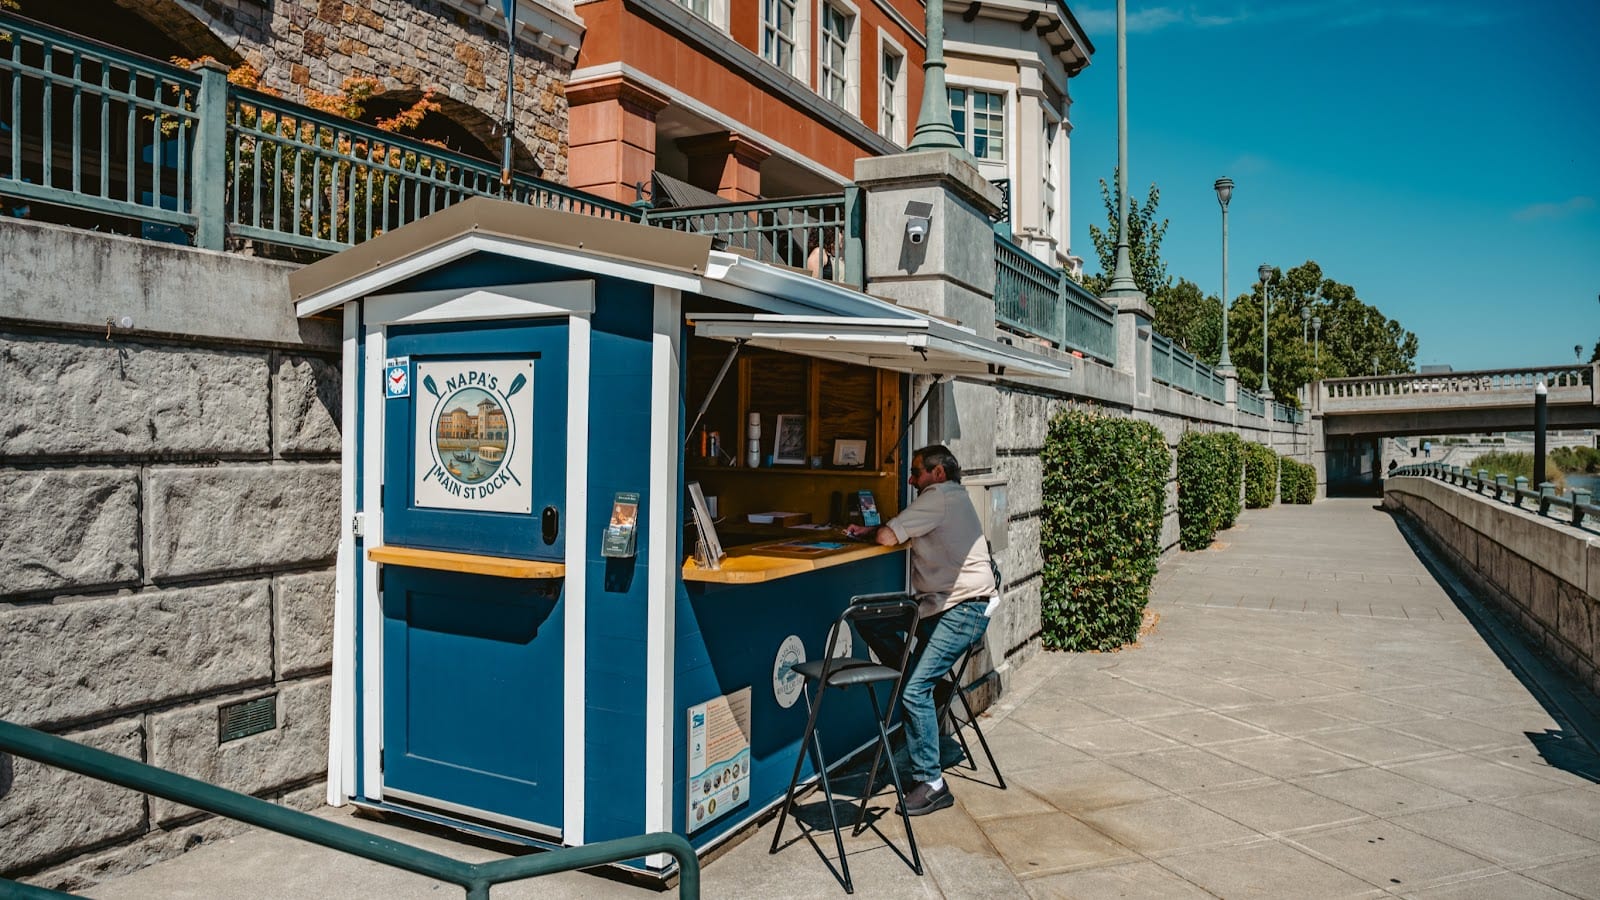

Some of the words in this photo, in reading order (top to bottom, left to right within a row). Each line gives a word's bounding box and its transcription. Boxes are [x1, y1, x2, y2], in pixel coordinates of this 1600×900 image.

[446, 371, 499, 393] NAPA'S
[433, 465, 462, 497] MAIN
[463, 487, 476, 500] ST
[479, 470, 511, 499] DOCK
